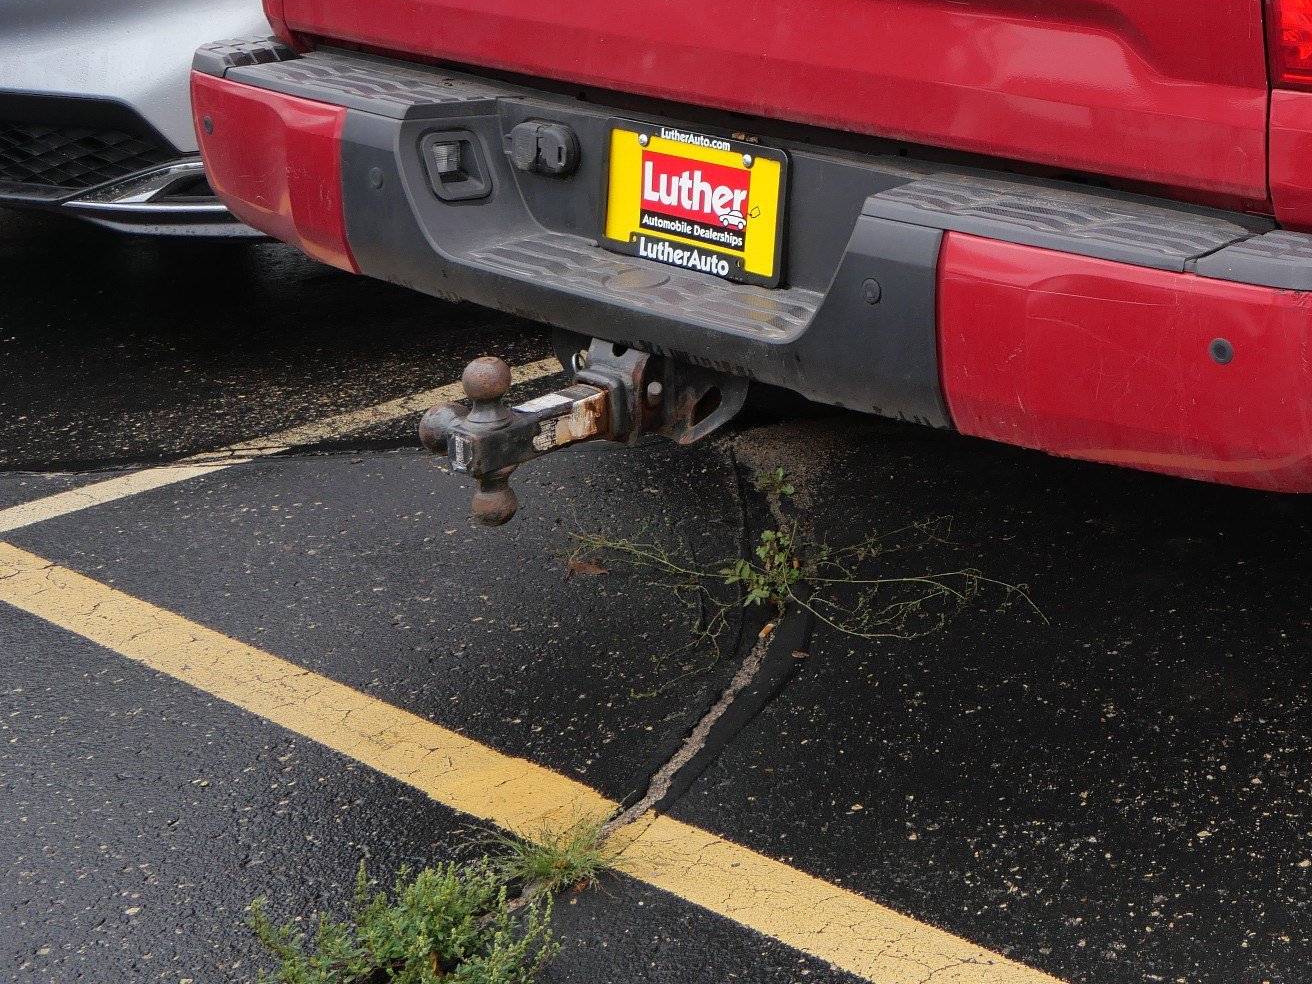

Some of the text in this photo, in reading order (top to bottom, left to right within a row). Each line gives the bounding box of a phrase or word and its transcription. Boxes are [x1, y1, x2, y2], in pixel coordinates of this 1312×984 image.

[660, 127, 731, 152] LutherAuto.com
[643, 161, 748, 216] Luther
[642, 213, 743, 247] Automobile Dealerships
[639, 236, 730, 277] LutherAuto
